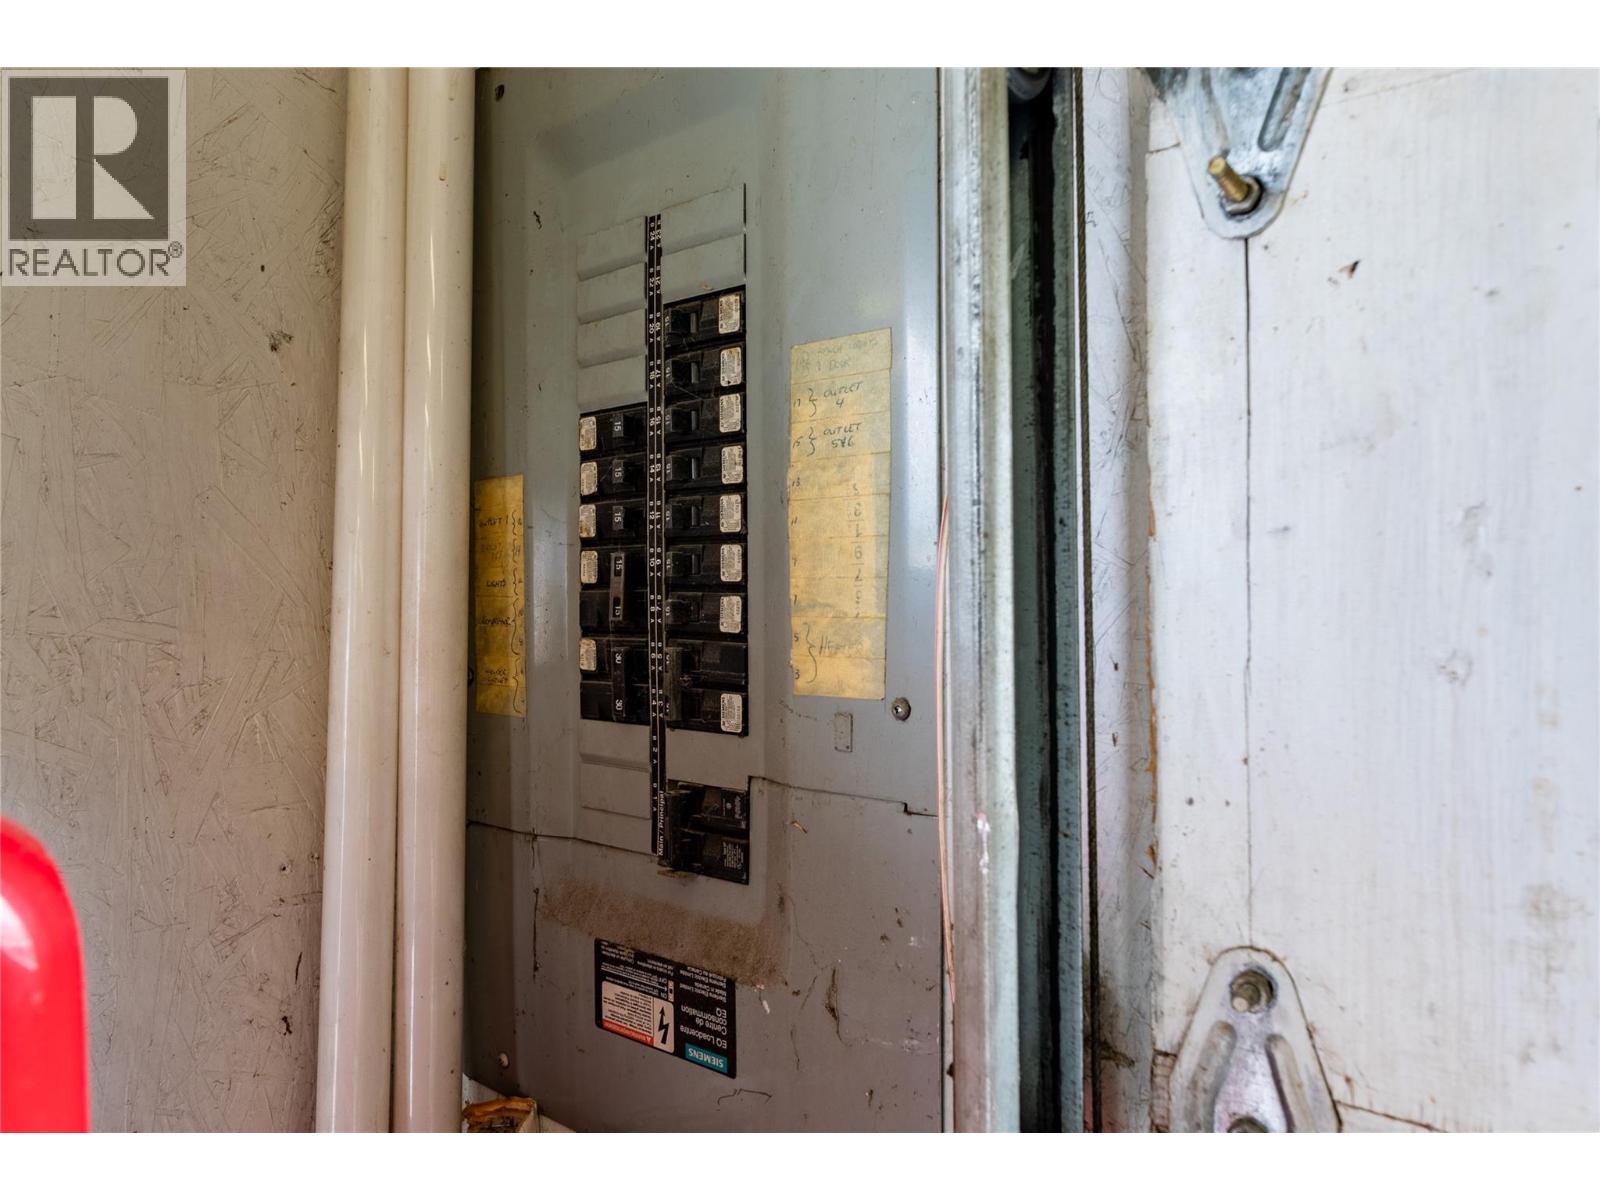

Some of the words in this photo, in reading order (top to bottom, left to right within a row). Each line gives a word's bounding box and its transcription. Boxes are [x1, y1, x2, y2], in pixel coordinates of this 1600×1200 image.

[650, 232, 654, 240] 24
[650, 278, 654, 287] 22
[649, 324, 654, 333] 20
[650, 371, 654, 379] 18
[835, 398, 845, 409] 4
[650, 417, 654, 426] 16
[614, 422, 622, 432] 15
[823, 422, 863, 436] OUTLET
[614, 468, 622, 478] 15
[650, 465, 654, 473] 14
[614, 512, 622, 522] 15
[650, 511, 654, 519] 12
[615, 558, 622, 570] 15
[650, 558, 654, 566] 10
[615, 653, 622, 664] 30
[615, 699, 623, 710] 30
[681, 1004, 727, 1025] consommation
[716, 1007, 727, 1018] EQ
[696, 1017, 704, 1026] de
[705, 1022, 727, 1035] Centre
[680, 1025, 715, 1045] Loadcentre
[716, 1040, 727, 1049] EQ
[688, 1048, 724, 1068] SIEMENS
